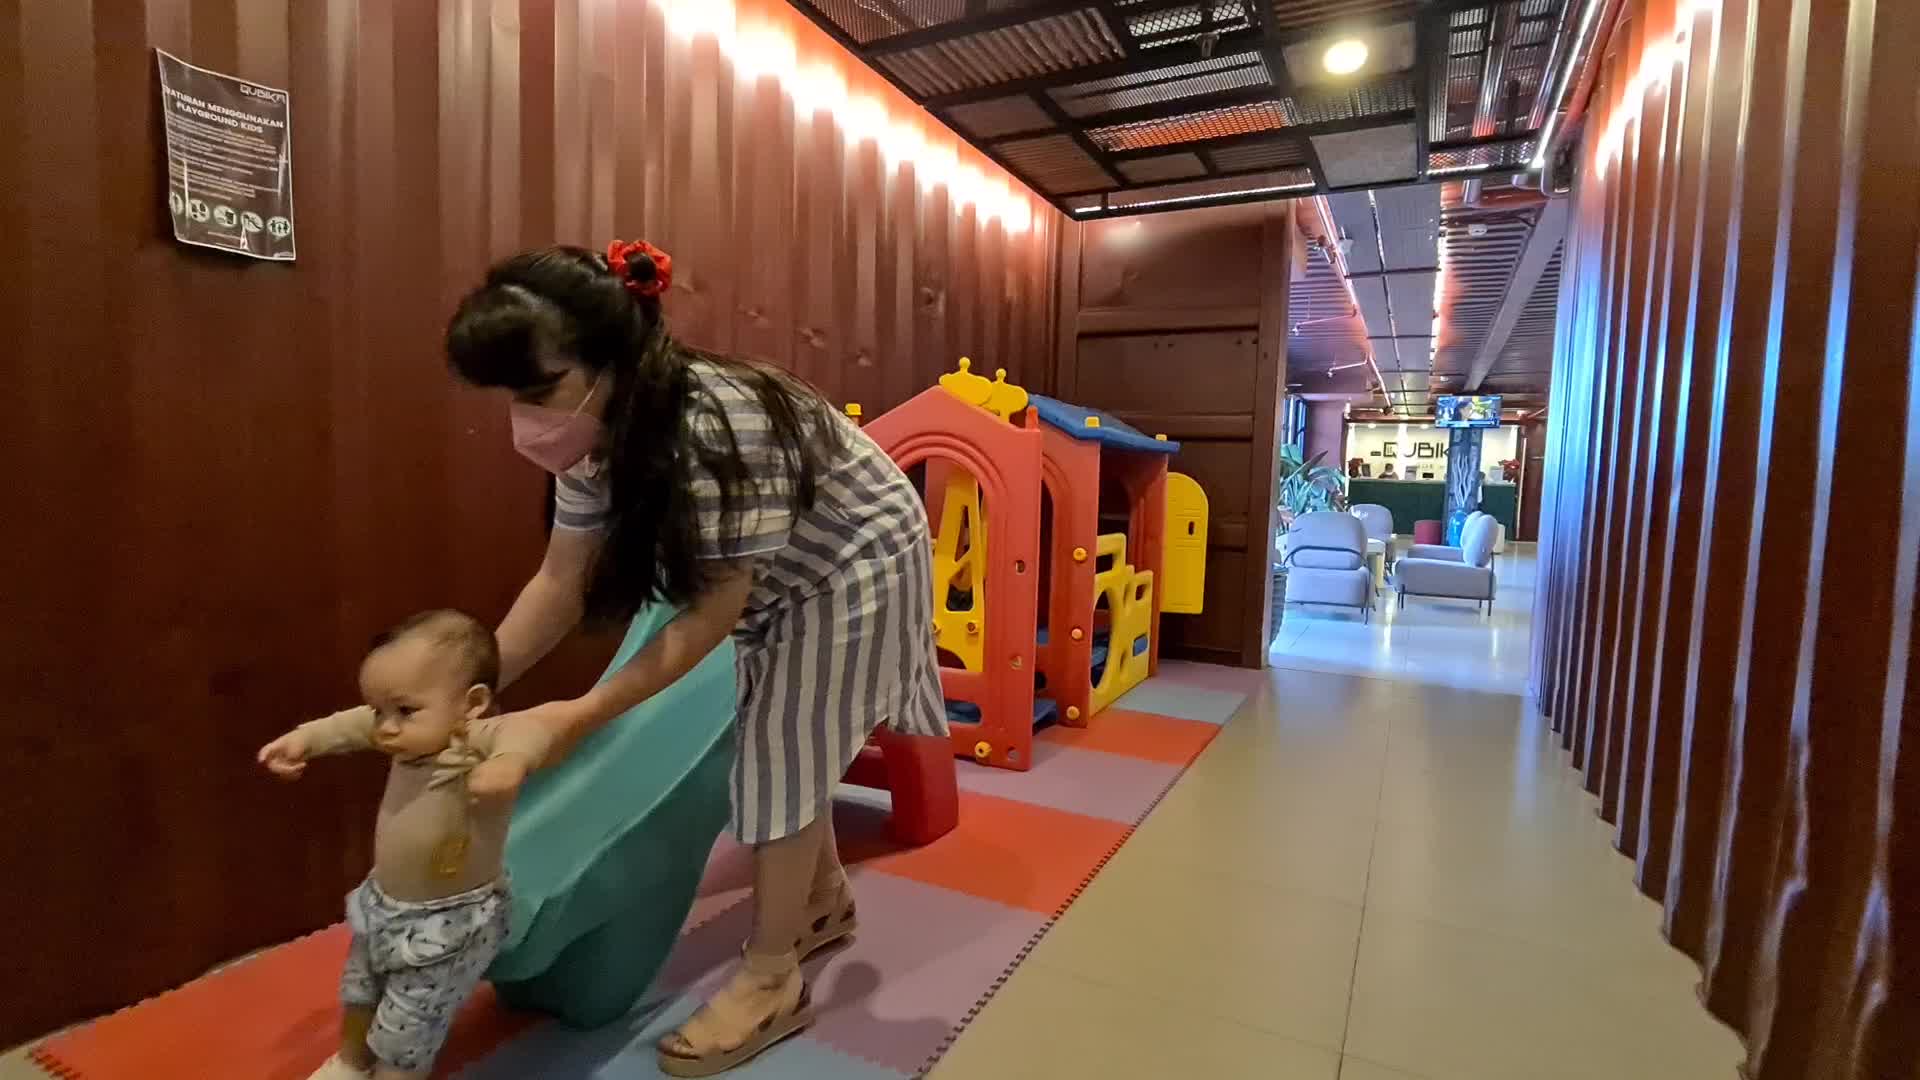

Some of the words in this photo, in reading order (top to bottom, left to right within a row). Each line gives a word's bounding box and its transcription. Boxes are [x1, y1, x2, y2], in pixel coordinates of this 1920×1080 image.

[176, 101, 238, 127] PLAYGROUND
[240, 121, 264, 133] KIDS
[207, 103, 284, 129] MENGGUNAKAN
[1383, 442, 1450, 459] QUBIK
